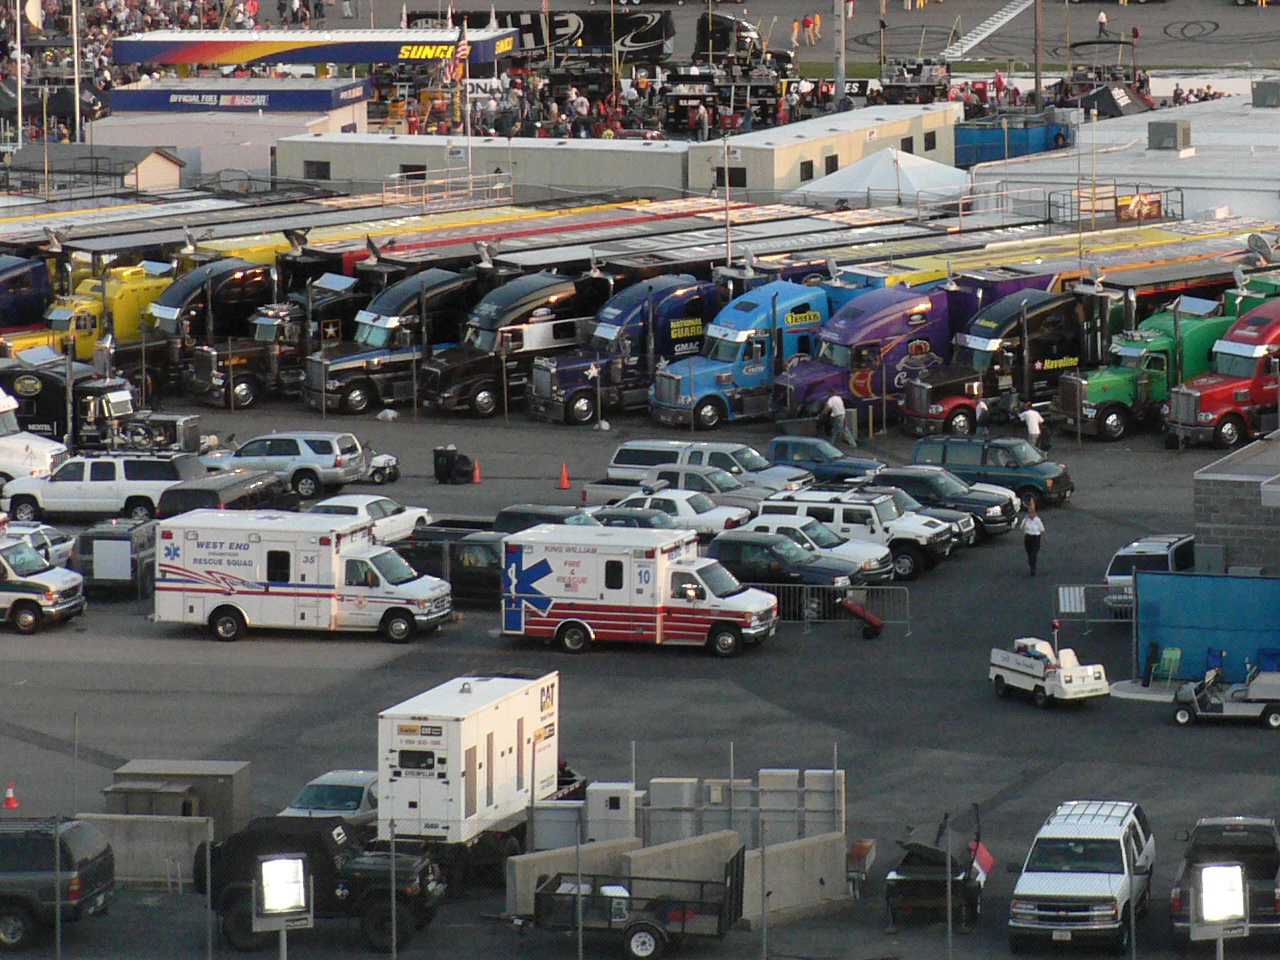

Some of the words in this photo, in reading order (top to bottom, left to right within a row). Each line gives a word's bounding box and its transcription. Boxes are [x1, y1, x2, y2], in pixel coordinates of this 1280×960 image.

[169, 94, 200, 102] OFFICIAL
[201, 95, 218, 104] FUEL
[233, 95, 269, 106] NASCAR
[785, 312, 820, 324] Cheerios
[671, 326, 703, 339] GUARD
[674, 342, 700, 352] GMAC
[1043, 356, 1079, 370] Havoline
[196, 540, 225, 550] WEST
[229, 542, 251, 551] END
[544, 545, 563, 553] KING
[565, 546, 598, 554] WILLIAM
[193, 557, 224, 566] RESCUE
[226, 558, 253, 567] SQUAD
[302, 555, 315, 564] 35
[564, 560, 581, 568] FIRE
[556, 576, 589, 584] RESCUE
[637, 569, 650, 585] 10
[540, 682, 556, 712] CAT
